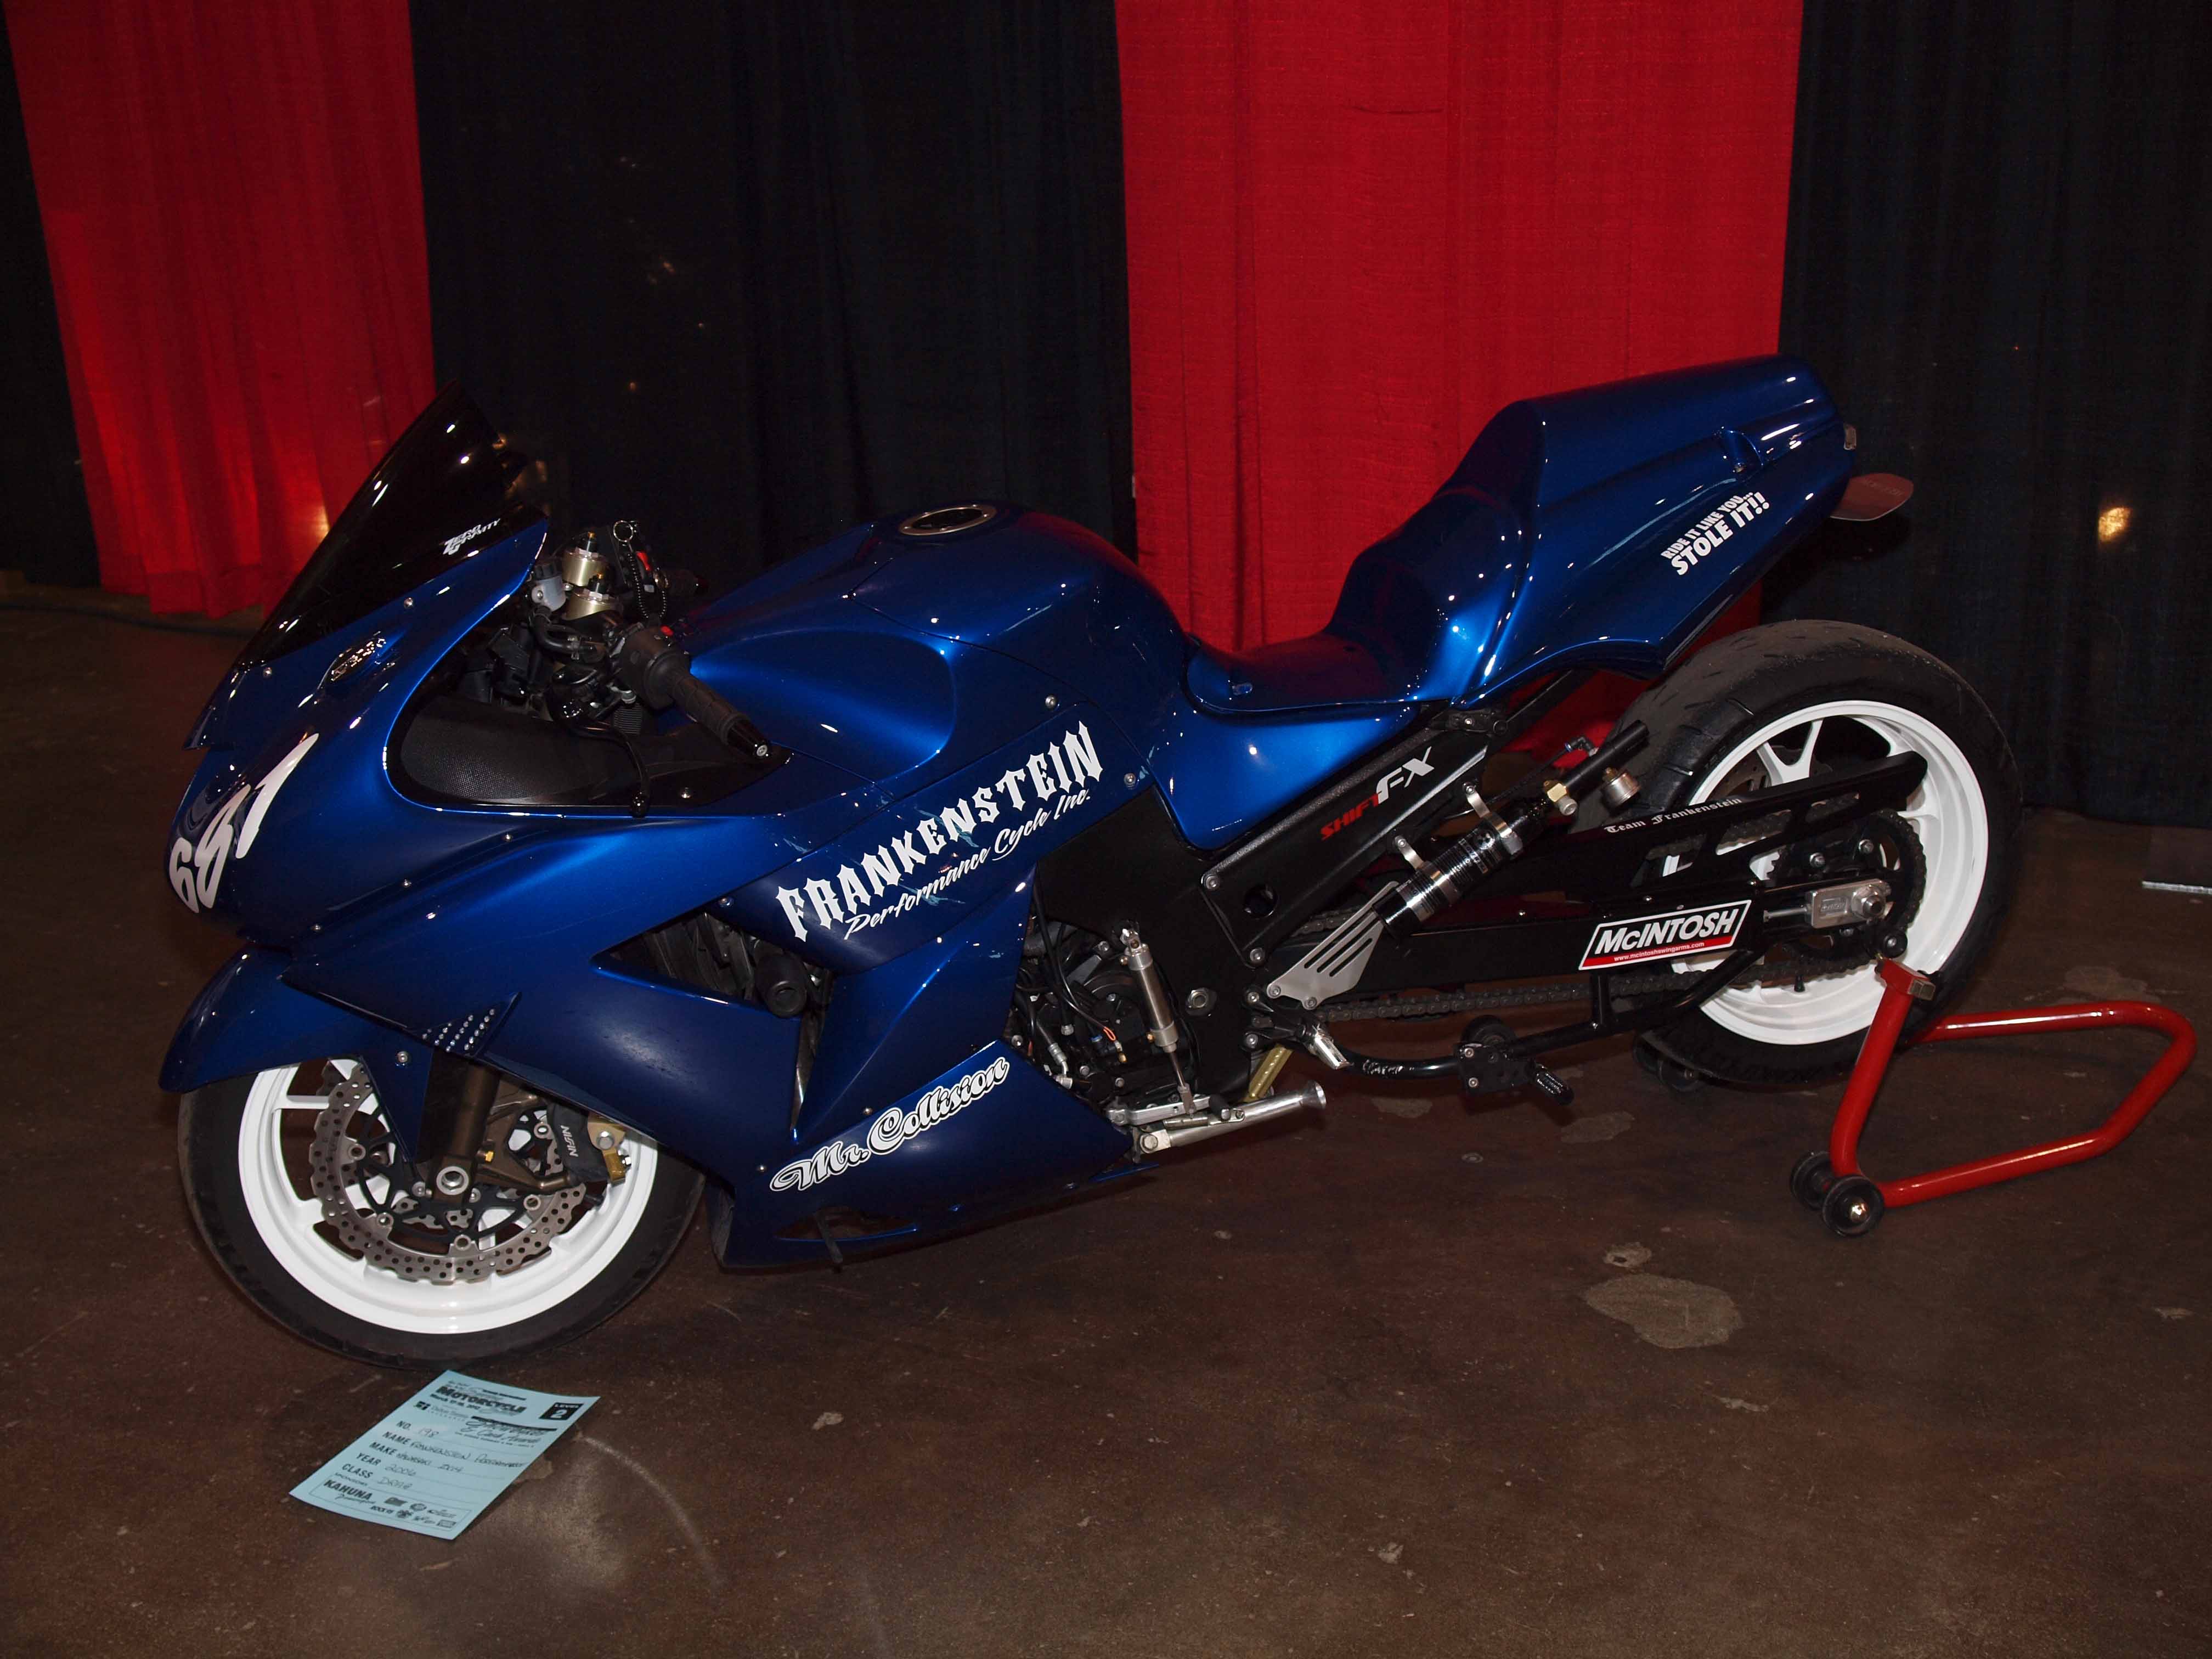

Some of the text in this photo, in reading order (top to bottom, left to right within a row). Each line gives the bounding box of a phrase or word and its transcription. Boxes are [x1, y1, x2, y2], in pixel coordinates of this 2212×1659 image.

[1661, 538, 1691, 559] RIDE
[1684, 528, 1701, 540] IT
[1696, 511, 1724, 531] LIKE
[1671, 492, 1770, 575] STOLE IT!!
[776, 720, 1103, 942] FRANKENSTEIN
[1604, 798, 1742, 833] Team Frankenstein
[844, 788, 1090, 940] Performance Cycle Inc.
[1594, 909, 1739, 955] McINTOSH
[1614, 941, 1705, 962] www.mcintoshswingarms.com
[769, 1057, 1010, 1191] Mr. Collision
[560, 1125, 579, 1158] NISSIN
[550, 1409, 567, 1418] 2
[369, 1442, 398, 1455] MAKE
[382, 1431, 412, 1444] NAME
[342, 1463, 374, 1479] CLASS
[357, 1452, 382, 1466] YEAR
[324, 1480, 373, 1500] KAHUNA
